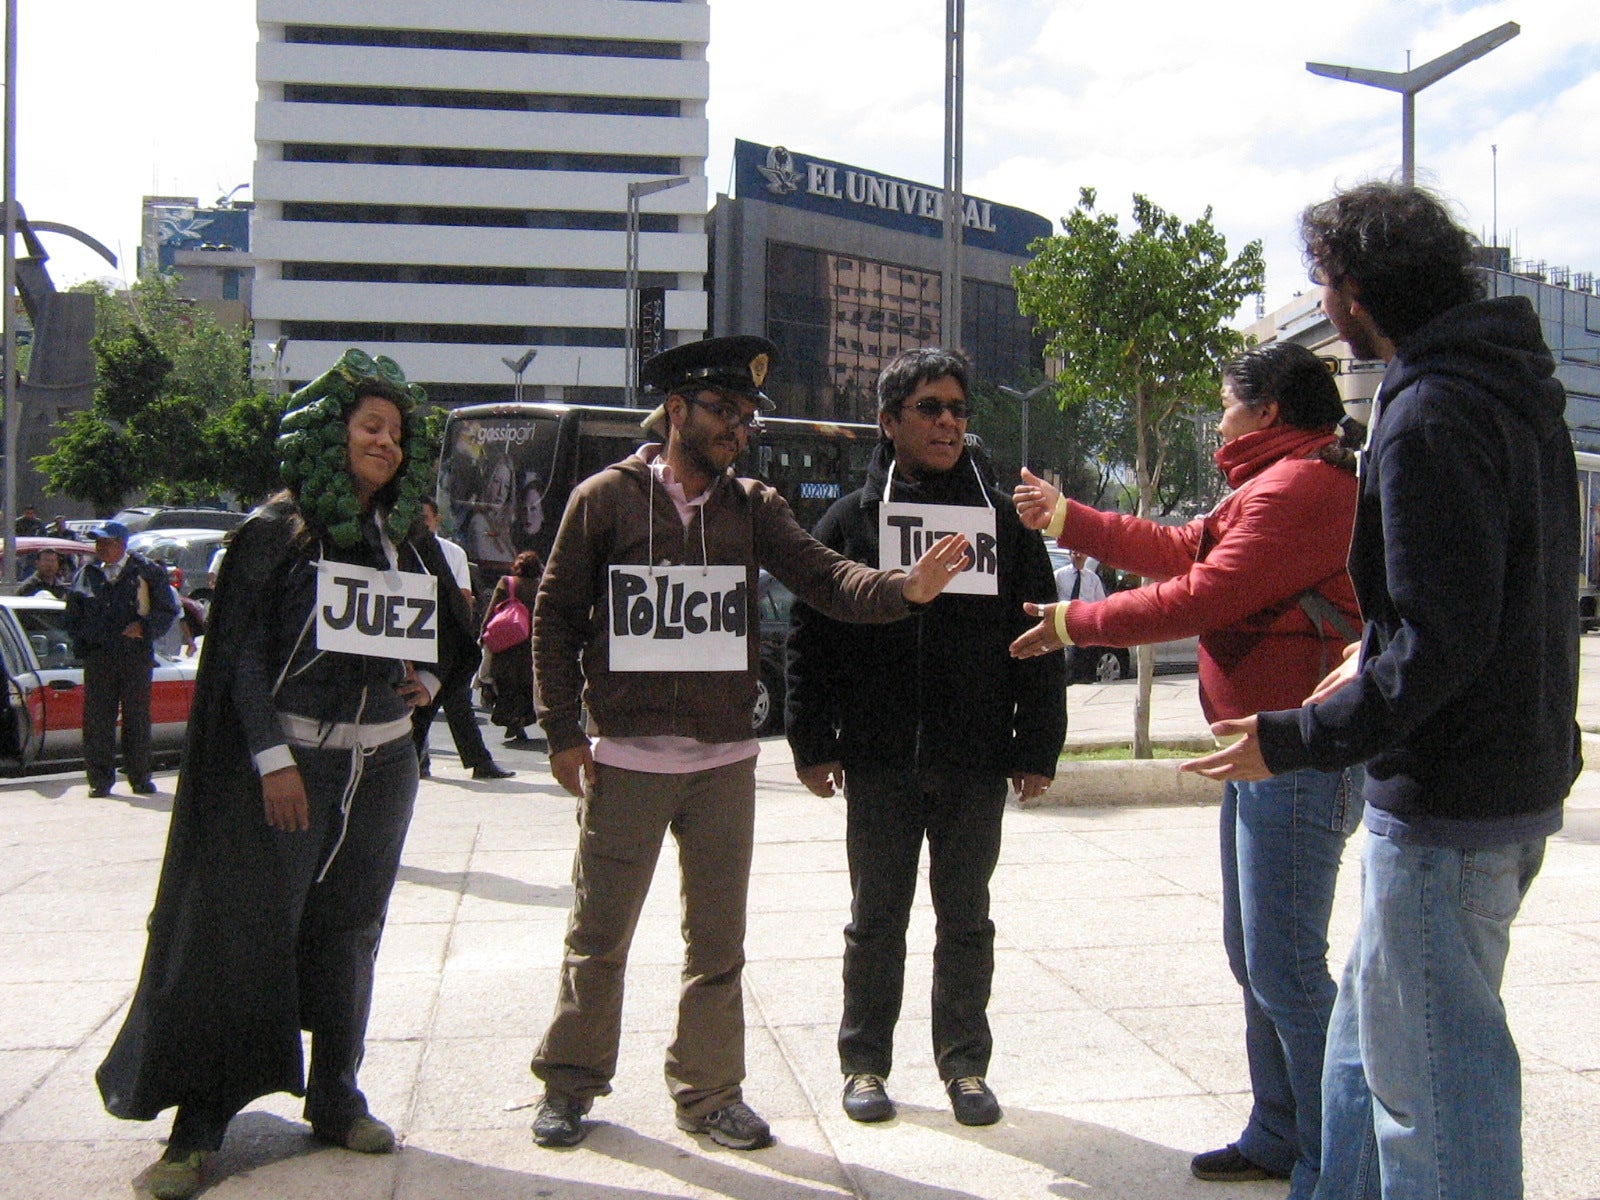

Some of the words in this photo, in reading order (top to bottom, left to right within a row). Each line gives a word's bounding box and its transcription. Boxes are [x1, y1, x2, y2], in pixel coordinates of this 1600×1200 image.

[806, 162, 842, 199] EL
[847, 171, 996, 232] UNIVEAL
[322, 576, 436, 639] JUEZ
